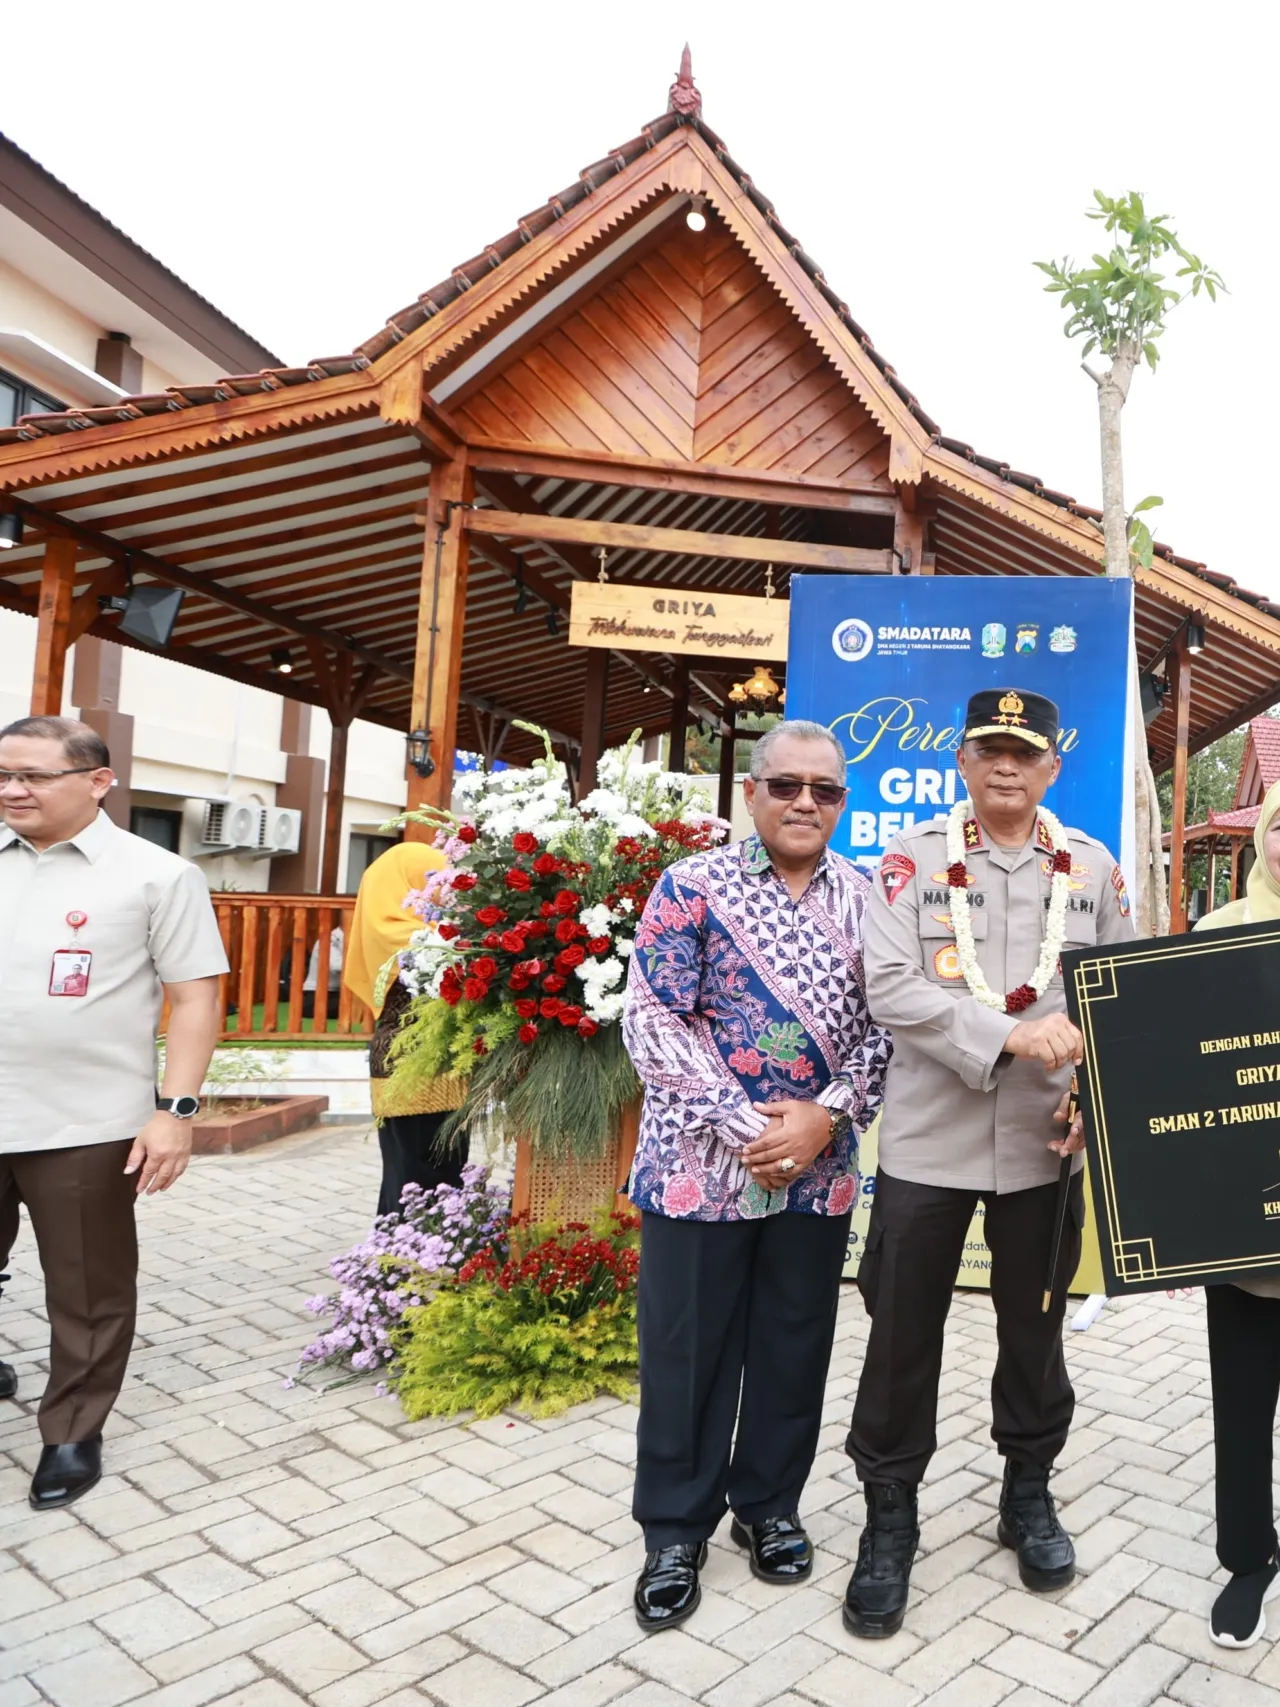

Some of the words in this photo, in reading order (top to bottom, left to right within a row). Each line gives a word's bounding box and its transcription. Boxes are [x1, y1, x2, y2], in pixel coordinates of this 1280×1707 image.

[652, 599, 716, 617] GRIYA
[877, 626, 971, 641] SMADATARA
[1199, 1035, 1252, 1055] DENGAN
[1148, 1112, 1201, 1135] SMAN
[1203, 1110, 1216, 1128] 2
